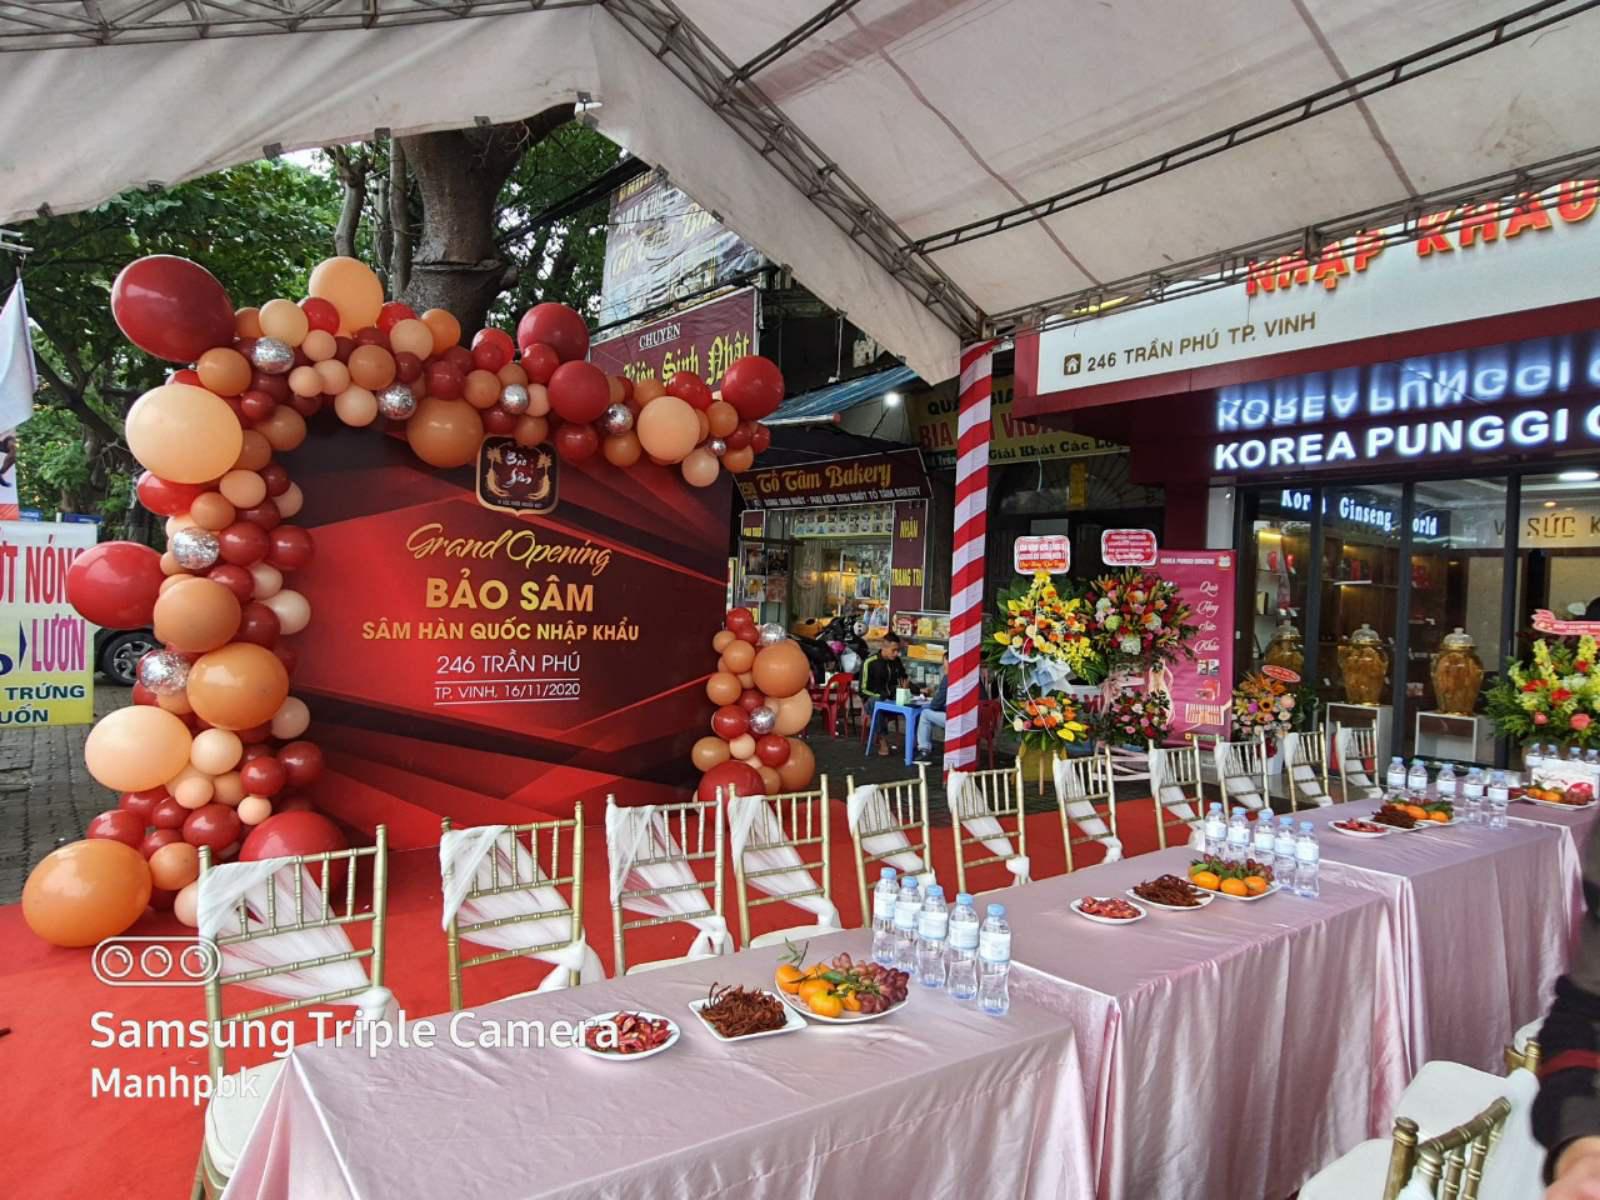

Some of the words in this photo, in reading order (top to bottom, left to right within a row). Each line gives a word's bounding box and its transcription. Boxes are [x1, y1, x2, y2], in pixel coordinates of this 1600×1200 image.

[1087, 352, 1117, 372] 246
[1124, 338, 1174, 364] TRẦN
[1179, 328, 1220, 355] PHÚ
[1264, 312, 1316, 338] VINH
[1214, 430, 1356, 471] KOREA
[1367, 408, 1569, 459] PUNGGI
[824, 463, 892, 489] Bakery
[1339, 496, 1392, 532] Ginseng
[1527, 513, 1576, 538] SỨC
[406, 523, 512, 561] Grand
[506, 529, 613, 577] Opening
[25, 533, 86, 604] NÓN
[425, 567, 510, 611] BẢO
[520, 574, 595, 612] SÂM
[31, 613, 85, 673] LƯƠN
[362, 616, 411, 641] SÂM
[418, 616, 464, 641] HÀN
[470, 616, 532, 641] QUỐC
[536, 619, 588, 645] NHẬP
[592, 615, 640, 641] KHẨU
[436, 655, 476, 675] 246
[481, 648, 536, 674] TRẦN
[541, 651, 581, 673] PHÚ
[4, 682, 85, 701] TRỨNG
[504, 683, 581, 698] 16/11/2020
